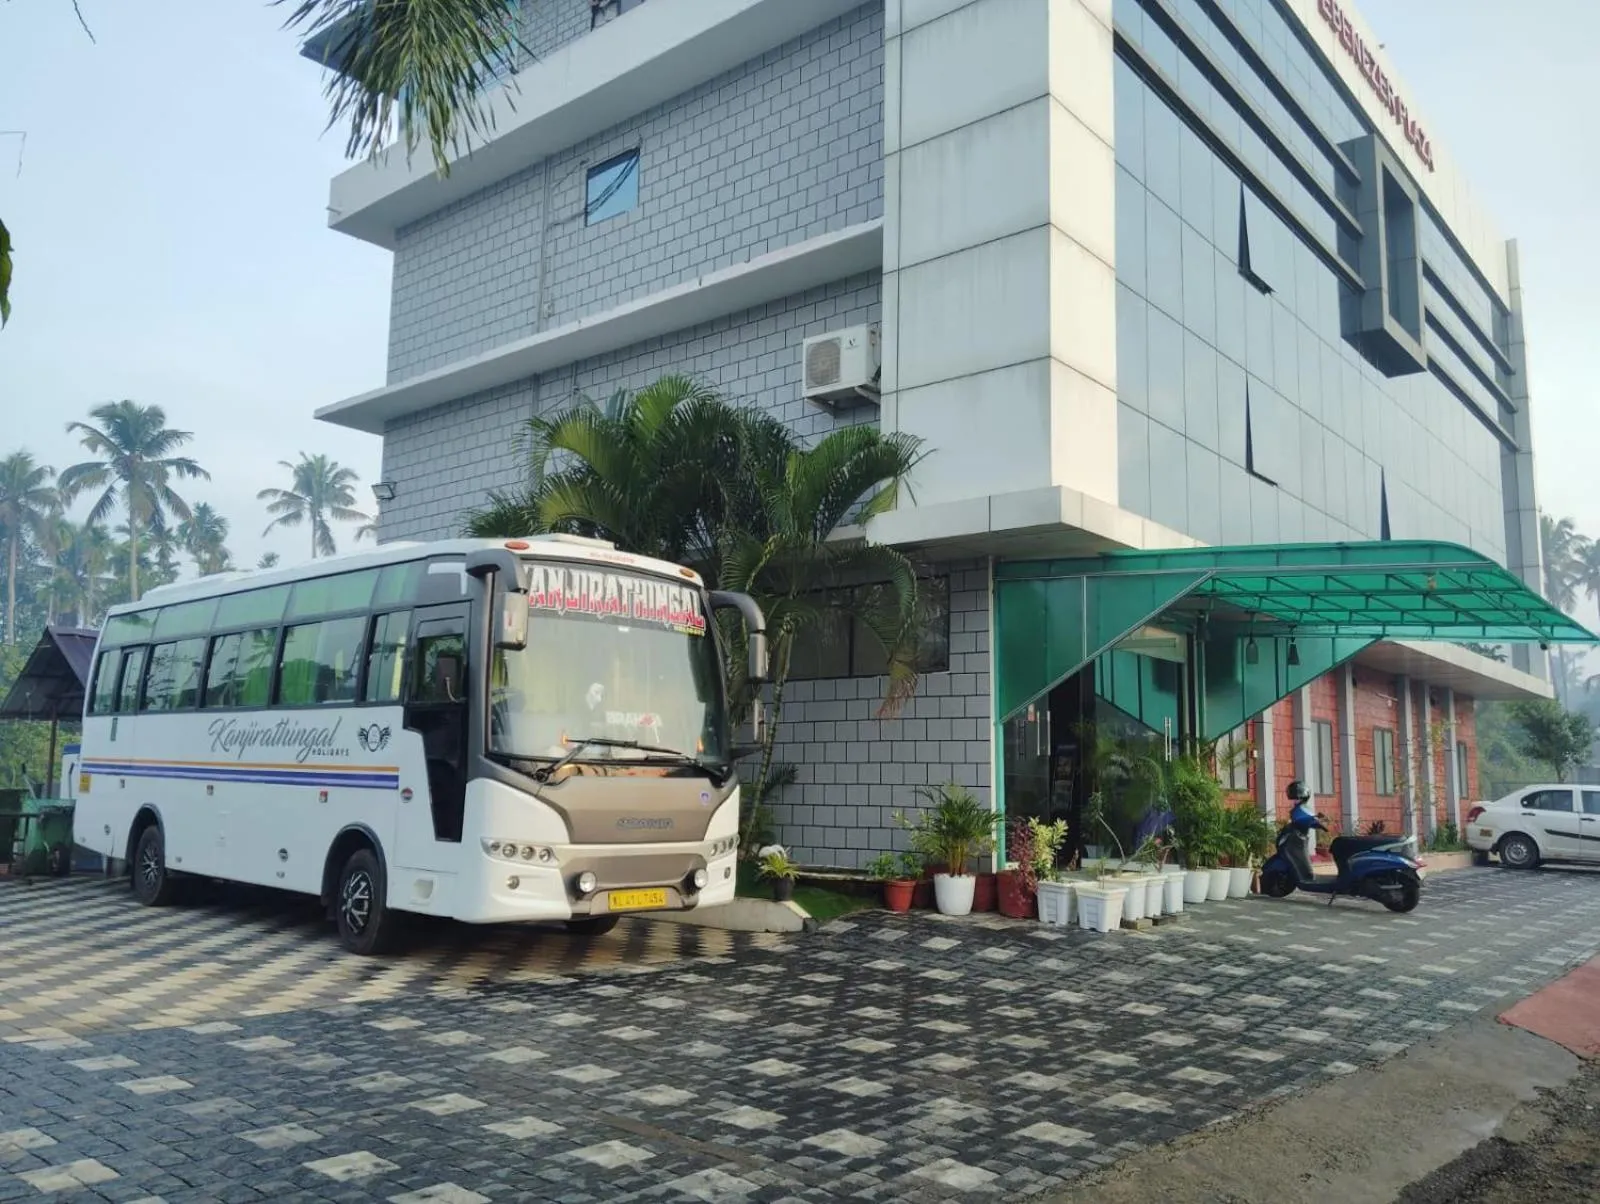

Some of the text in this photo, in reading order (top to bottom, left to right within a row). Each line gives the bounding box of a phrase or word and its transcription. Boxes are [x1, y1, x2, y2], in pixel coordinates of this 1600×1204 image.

[523, 564, 705, 632] ANJIRATHINGAL
[207, 716, 343, 763] Kanjirathingal
[312, 748, 349, 757] HOLIDAYS
